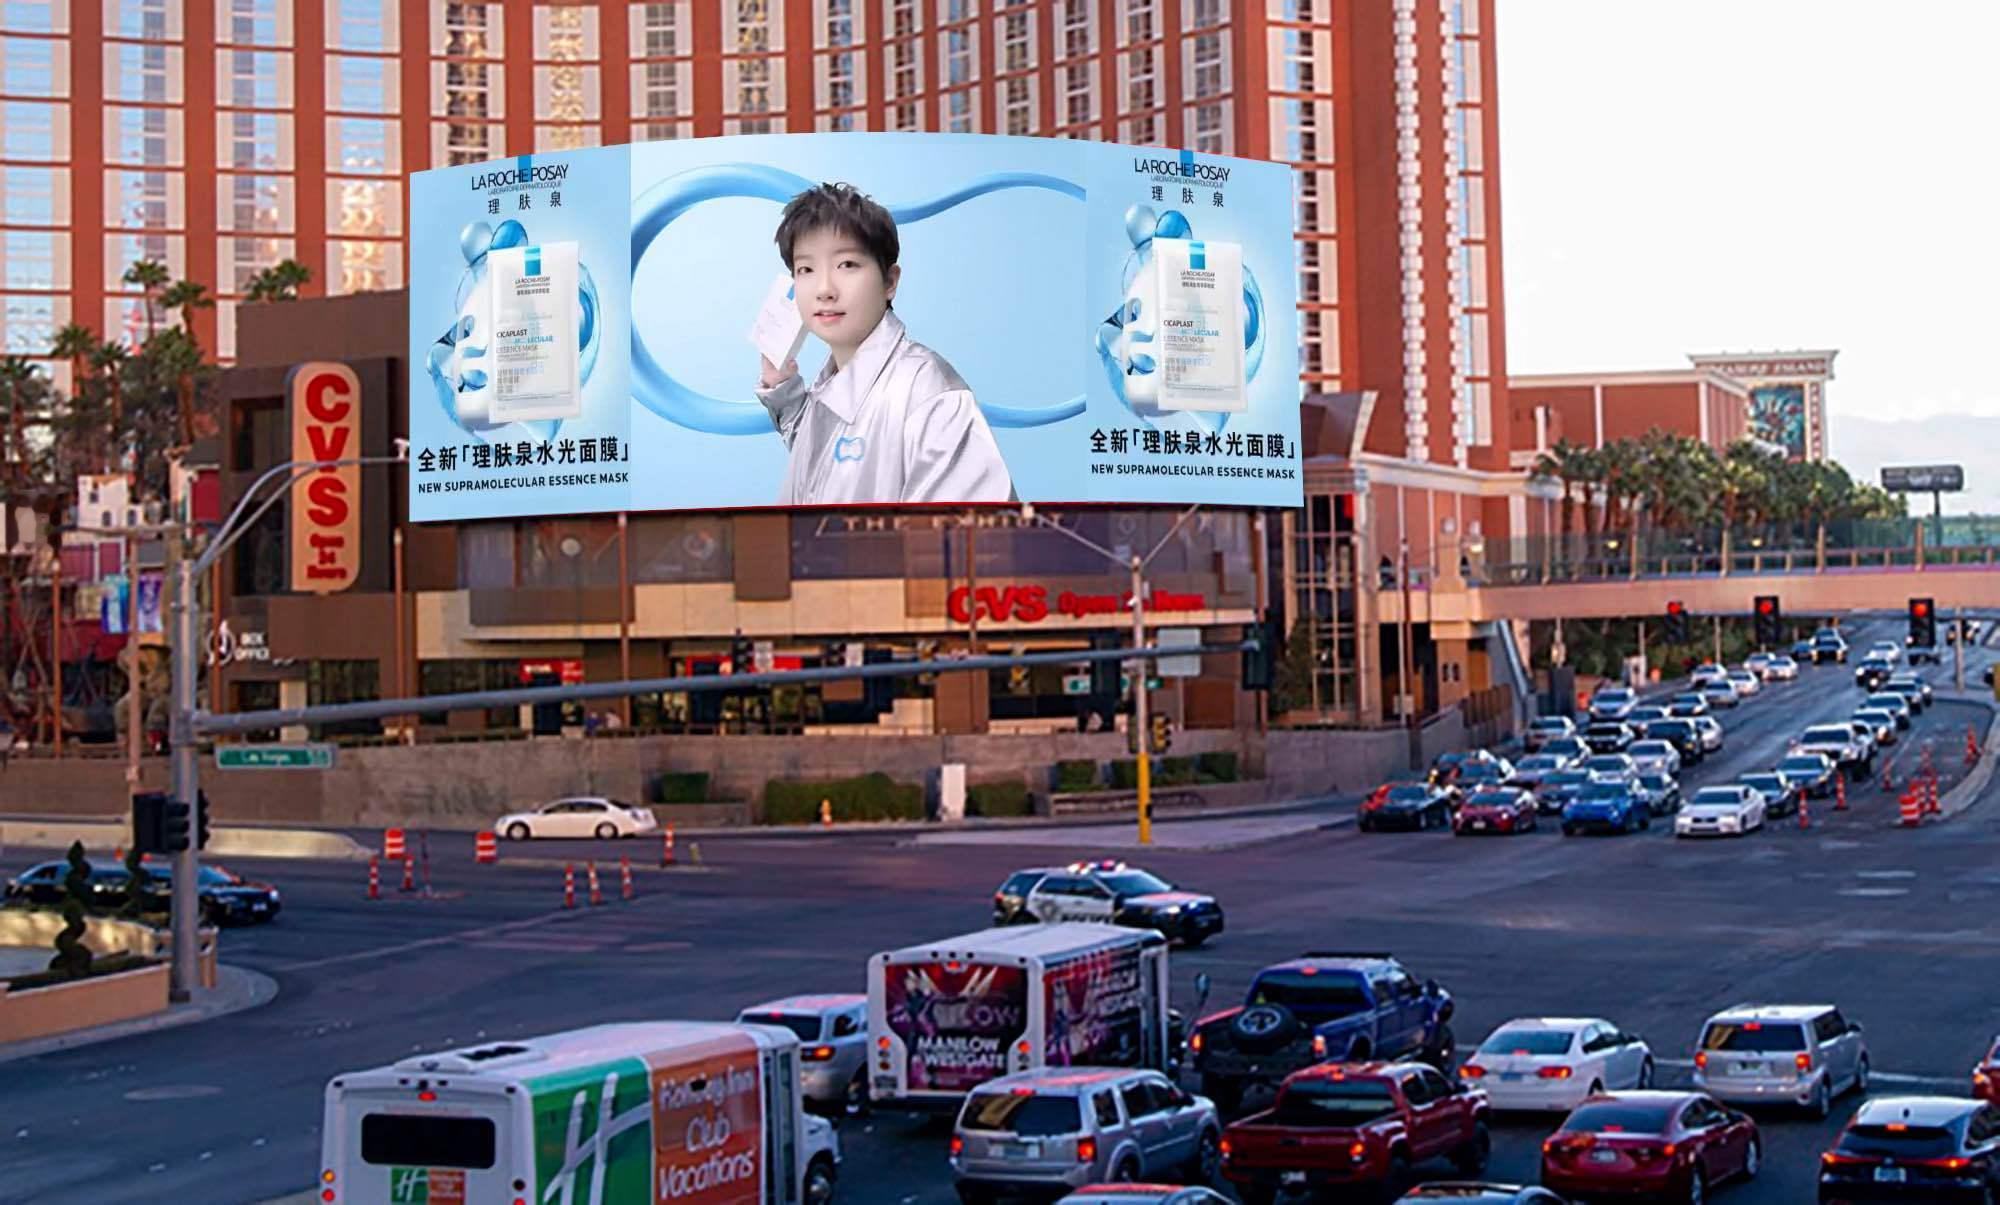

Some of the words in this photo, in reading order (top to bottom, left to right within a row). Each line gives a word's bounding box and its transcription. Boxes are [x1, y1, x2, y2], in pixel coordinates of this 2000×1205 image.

[1134, 158, 1150, 173] LA
[471, 175, 487, 191] LA
[306, 373, 351, 527] CVS
[418, 436, 629, 472] 全新「理肤泉水光面膜」
[1090, 428, 1295, 459] 全新「理肤泉水光面膜」
[418, 483, 442, 493] NEW
[445, 476, 545, 492] SUPRAMOLECULAR
[549, 474, 597, 486] ESSENCE
[600, 472, 629, 483] MASK
[1091, 464, 1114, 474] NEW
[1117, 464, 1214, 476] SUPRAMOLECULAR
[1217, 469, 1264, 478] ESSENCE
[1266, 469, 1295, 479] MASK
[947, 585, 1048, 623] CVS
[659, 1150, 754, 1200] Vacations
